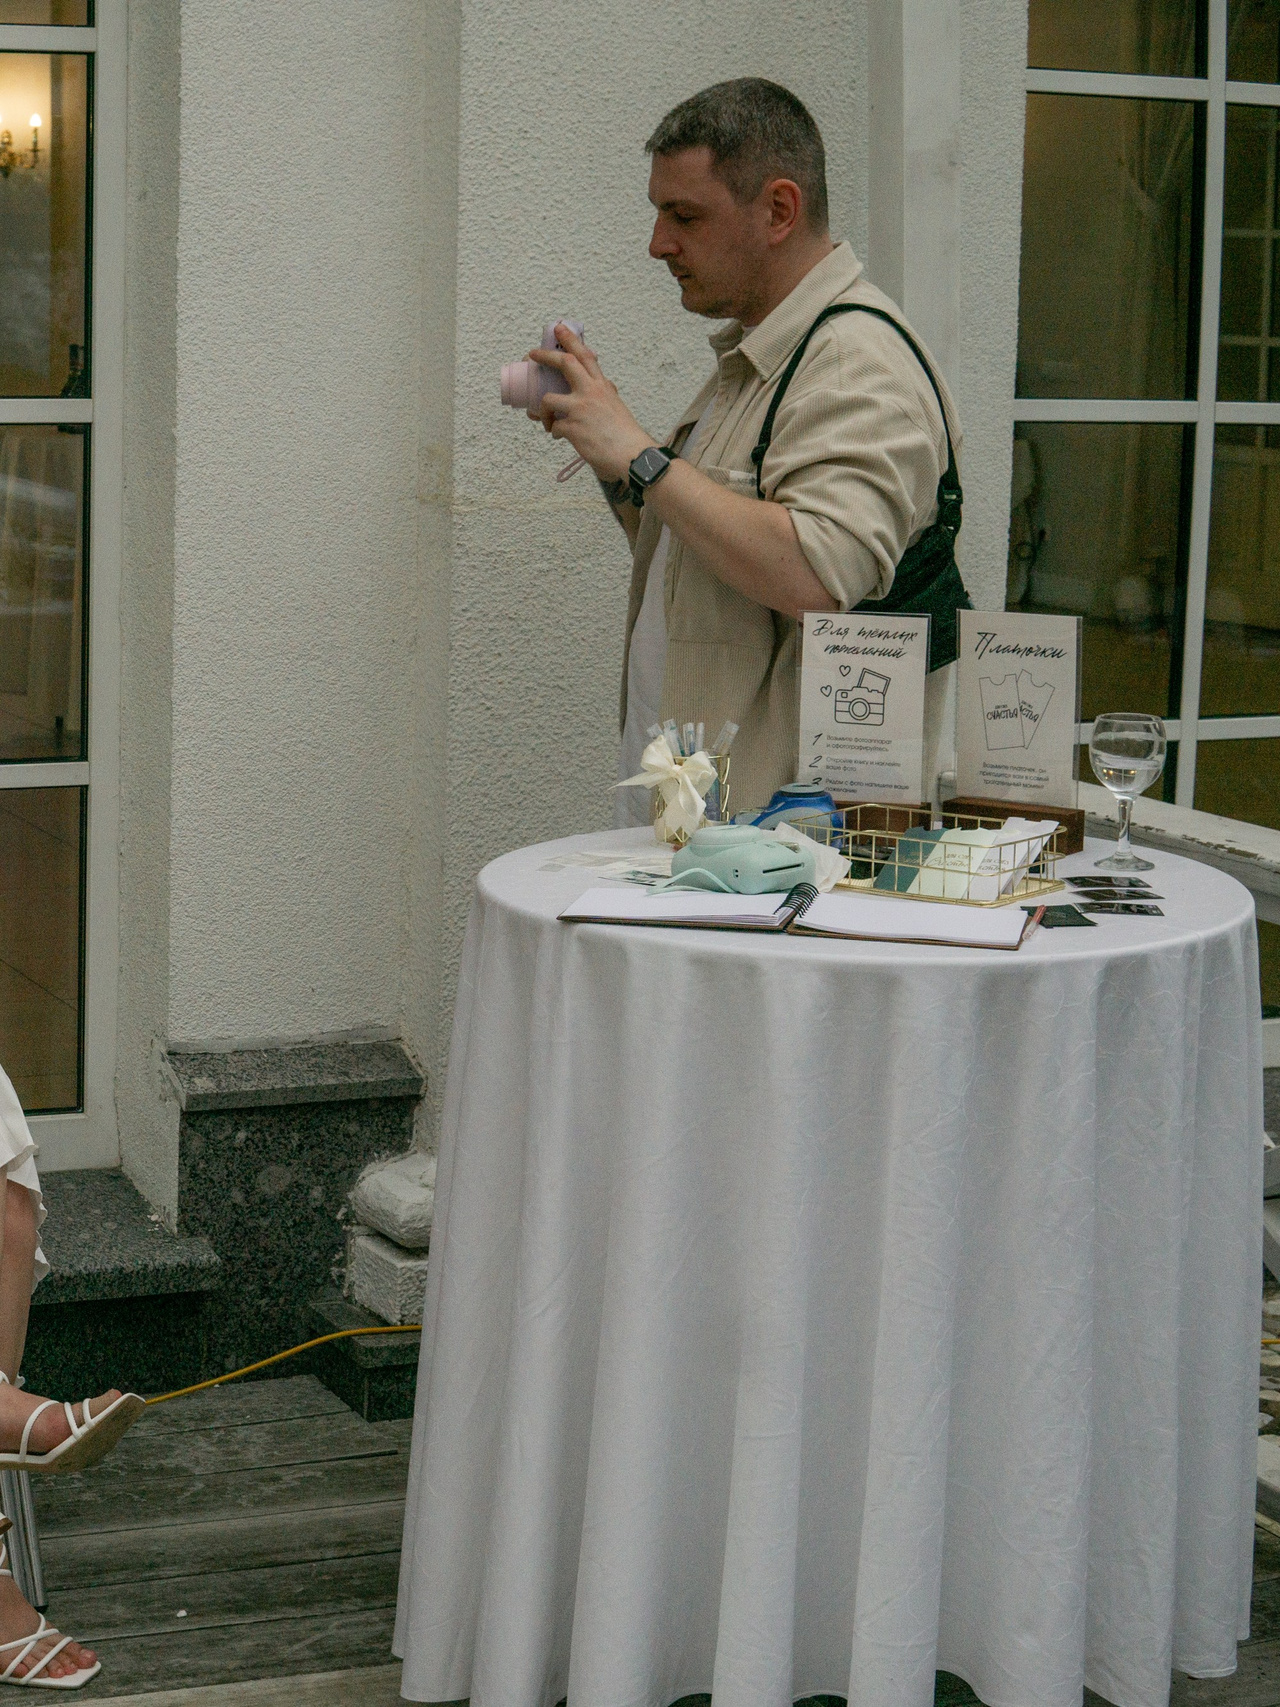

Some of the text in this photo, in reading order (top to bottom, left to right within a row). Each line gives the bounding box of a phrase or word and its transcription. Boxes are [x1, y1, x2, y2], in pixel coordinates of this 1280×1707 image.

[813, 619, 918, 645] Для тёплых
[824, 644, 907, 659] пожеланий
[975, 632, 1067, 660] Платочки
[986, 708, 1018, 720] СЧАСТЬЯ
[812, 733, 823, 746] 1
[808, 755, 823, 768] 2
